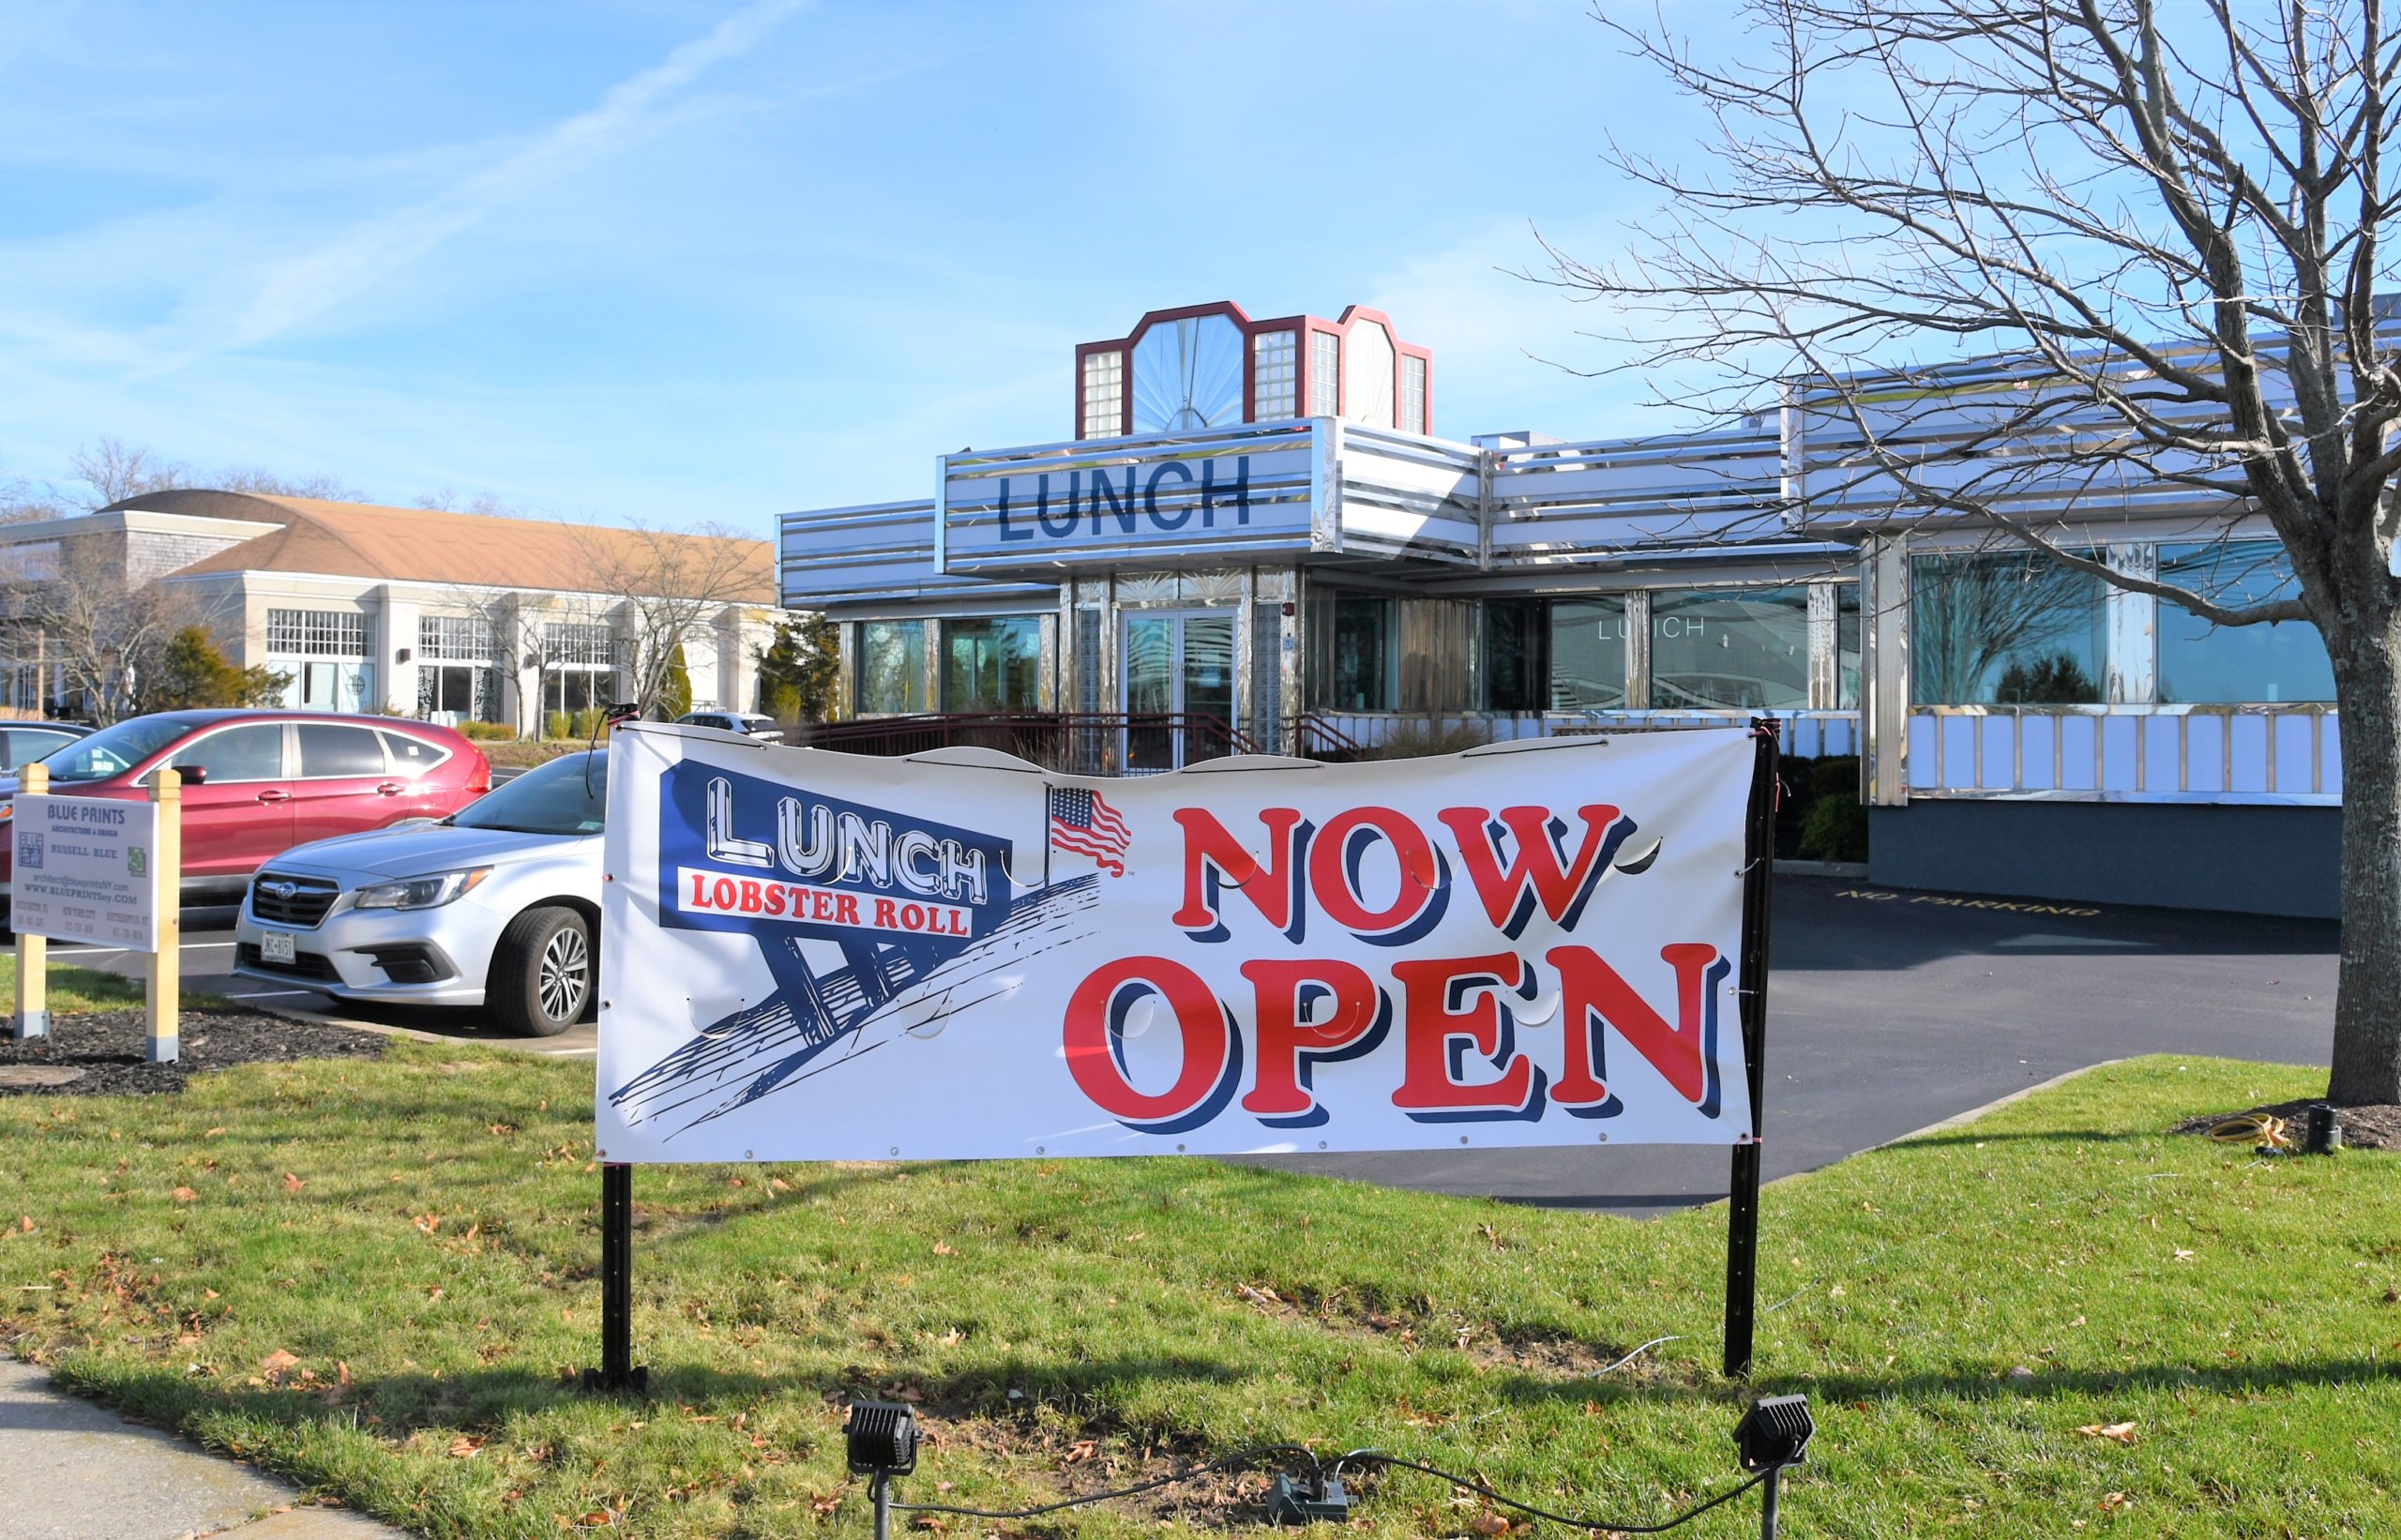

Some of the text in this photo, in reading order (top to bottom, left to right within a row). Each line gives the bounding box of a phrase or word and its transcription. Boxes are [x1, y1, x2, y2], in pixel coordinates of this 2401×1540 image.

[1000, 455, 1250, 542] LUNCH
[1598, 617, 1704, 640] LUCH
[48, 804, 125, 824] BLUE PRINTS
[706, 777, 989, 905] LUNCH
[51, 844, 118, 859] RUSSELL BLUE
[1172, 804, 1637, 945] NOW
[691, 873, 968, 937] LOBSTER ROLL
[1835, 890, 2101, 917] NO PARKING
[1062, 943, 1730, 1135] OPEN
